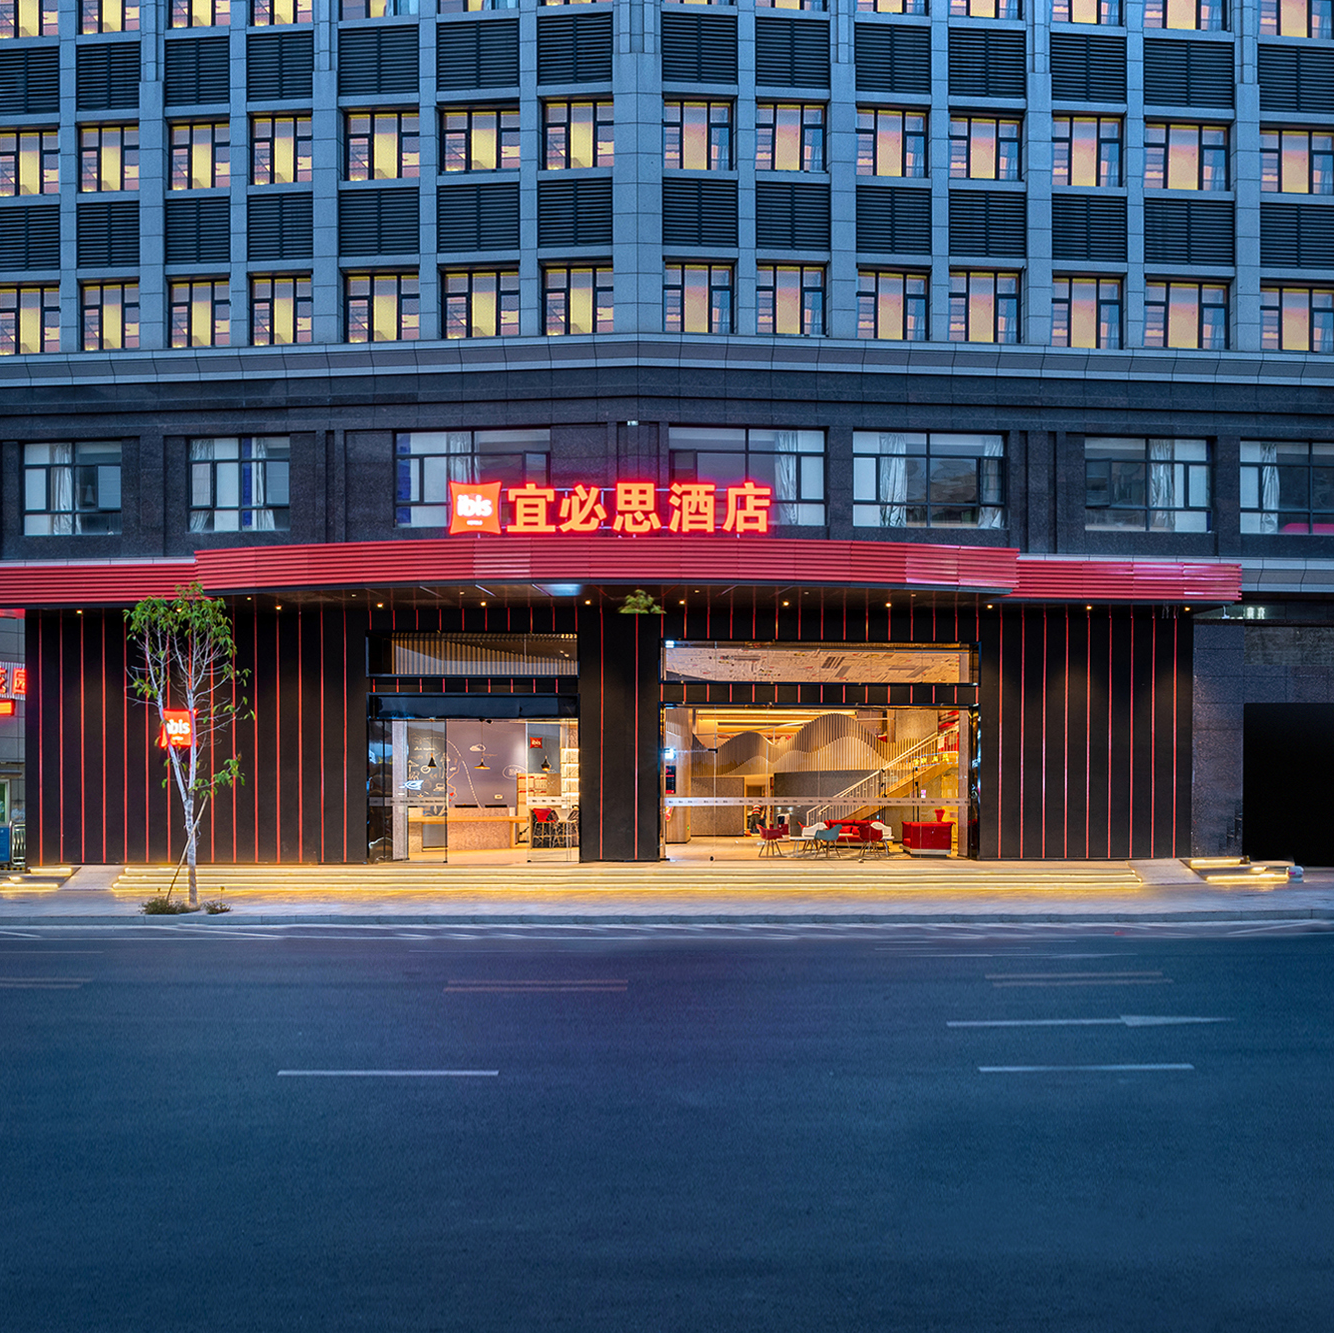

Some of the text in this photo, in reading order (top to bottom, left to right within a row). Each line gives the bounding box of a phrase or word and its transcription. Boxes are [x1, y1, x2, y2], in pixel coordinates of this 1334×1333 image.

[457, 494, 493, 517] ibis
[507, 483, 771, 533] 宜必思酒店
